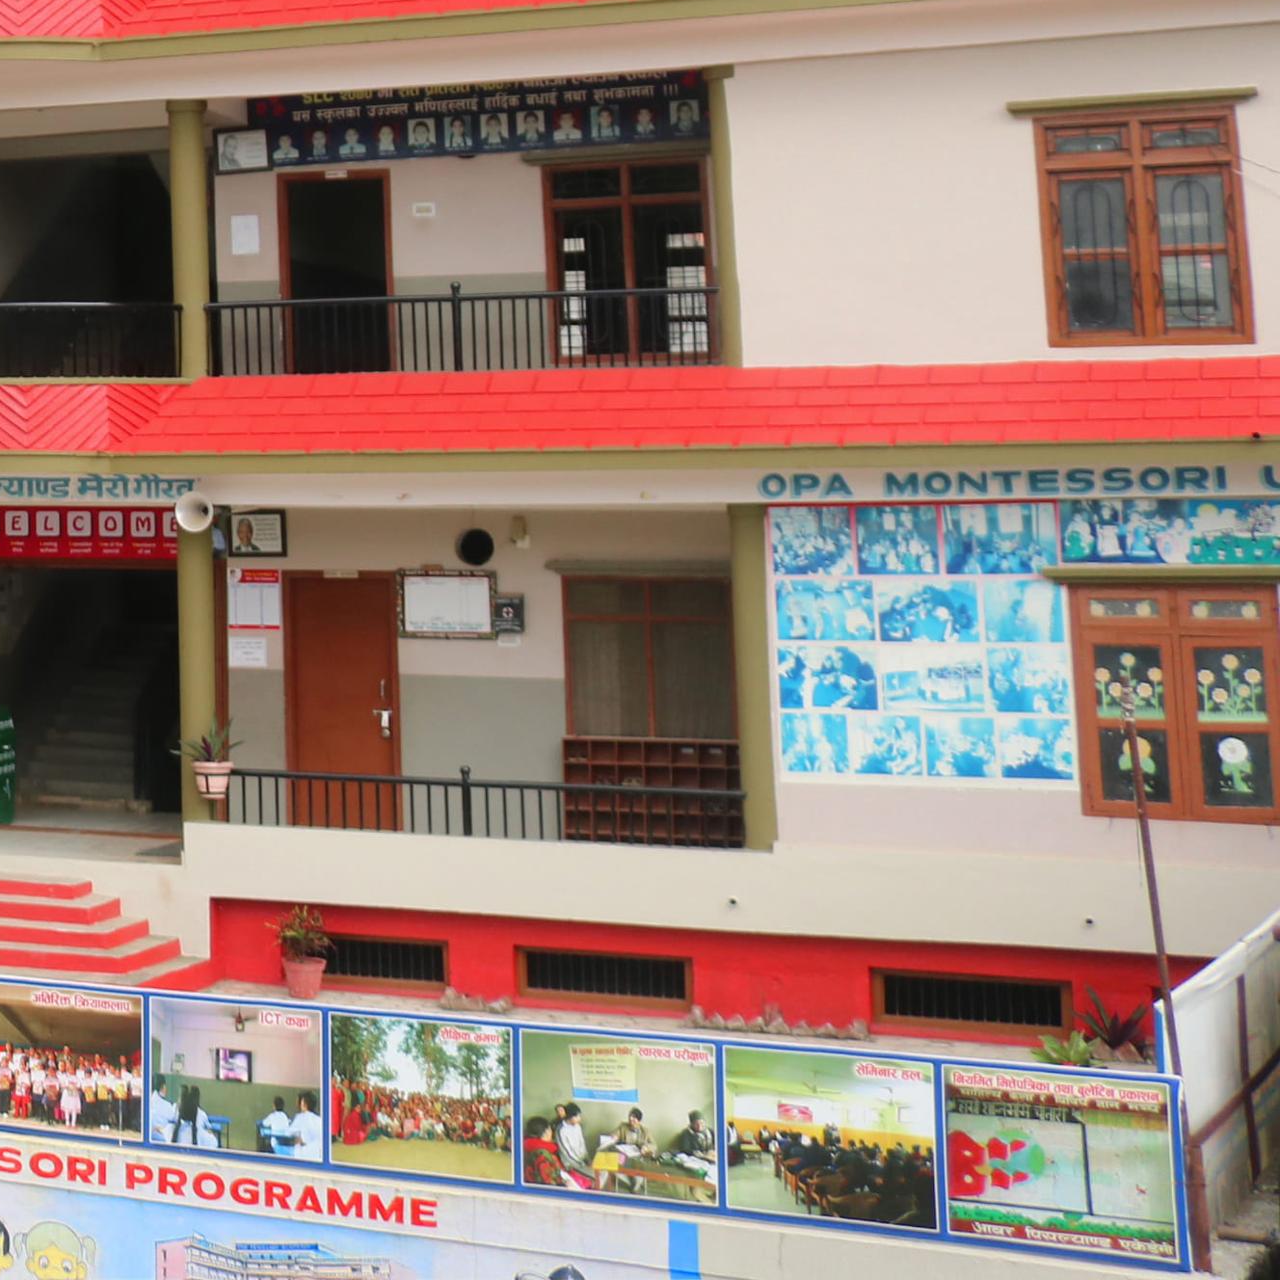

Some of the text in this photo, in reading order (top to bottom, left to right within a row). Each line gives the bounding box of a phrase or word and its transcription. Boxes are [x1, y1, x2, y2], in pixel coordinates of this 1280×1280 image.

[758, 473, 853, 499] OPA
[884, 465, 1229, 497] MONTESSORI
[259, 1011, 282, 1025] ICT
[125, 1162, 439, 1229] PROGRAMME
